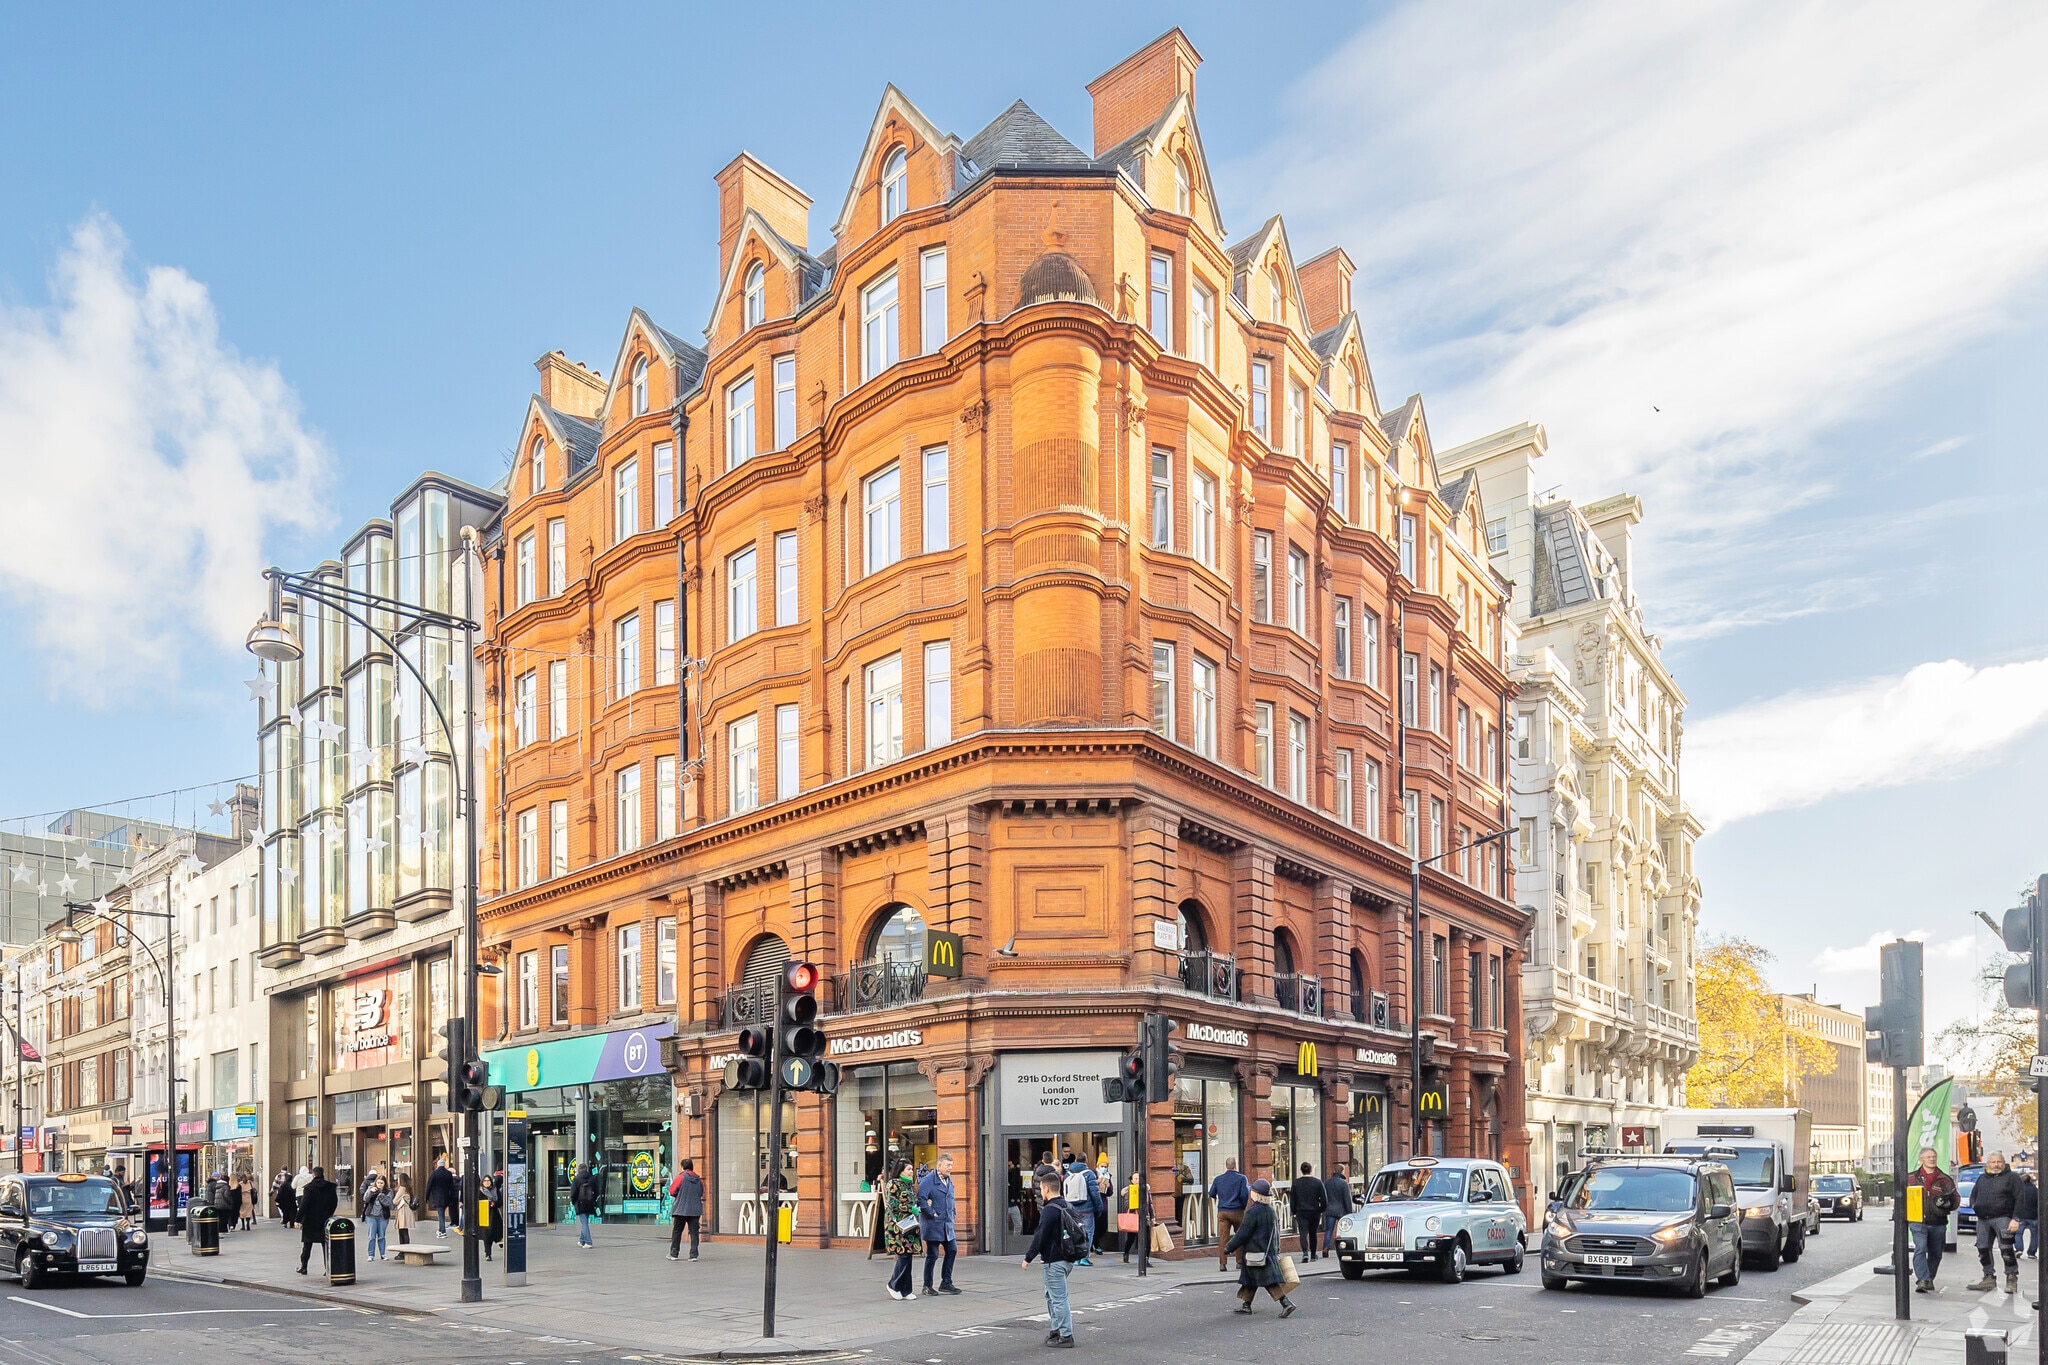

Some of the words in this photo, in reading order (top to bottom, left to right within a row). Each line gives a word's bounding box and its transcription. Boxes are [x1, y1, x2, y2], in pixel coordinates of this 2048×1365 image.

[1187, 1023, 1249, 1047] McDonald's
[359, 1034, 389, 1051] balance
[830, 1030, 922, 1055] McDonald's
[630, 1044, 643, 1061] BT
[1356, 1048, 1397, 1066] McDonald's
[1017, 1075, 1039, 1083] 291b
[1041, 1074, 1071, 1082] Oxford
[1073, 1074, 1100, 1082] Street
[1042, 1086, 1075, 1094] London
[1062, 1097, 1080, 1105] 2DT
[1487, 1228, 1505, 1240] CAZOO
[1587, 1255, 1610, 1263] BX68
[1611, 1256, 1628, 1264] WPZ
